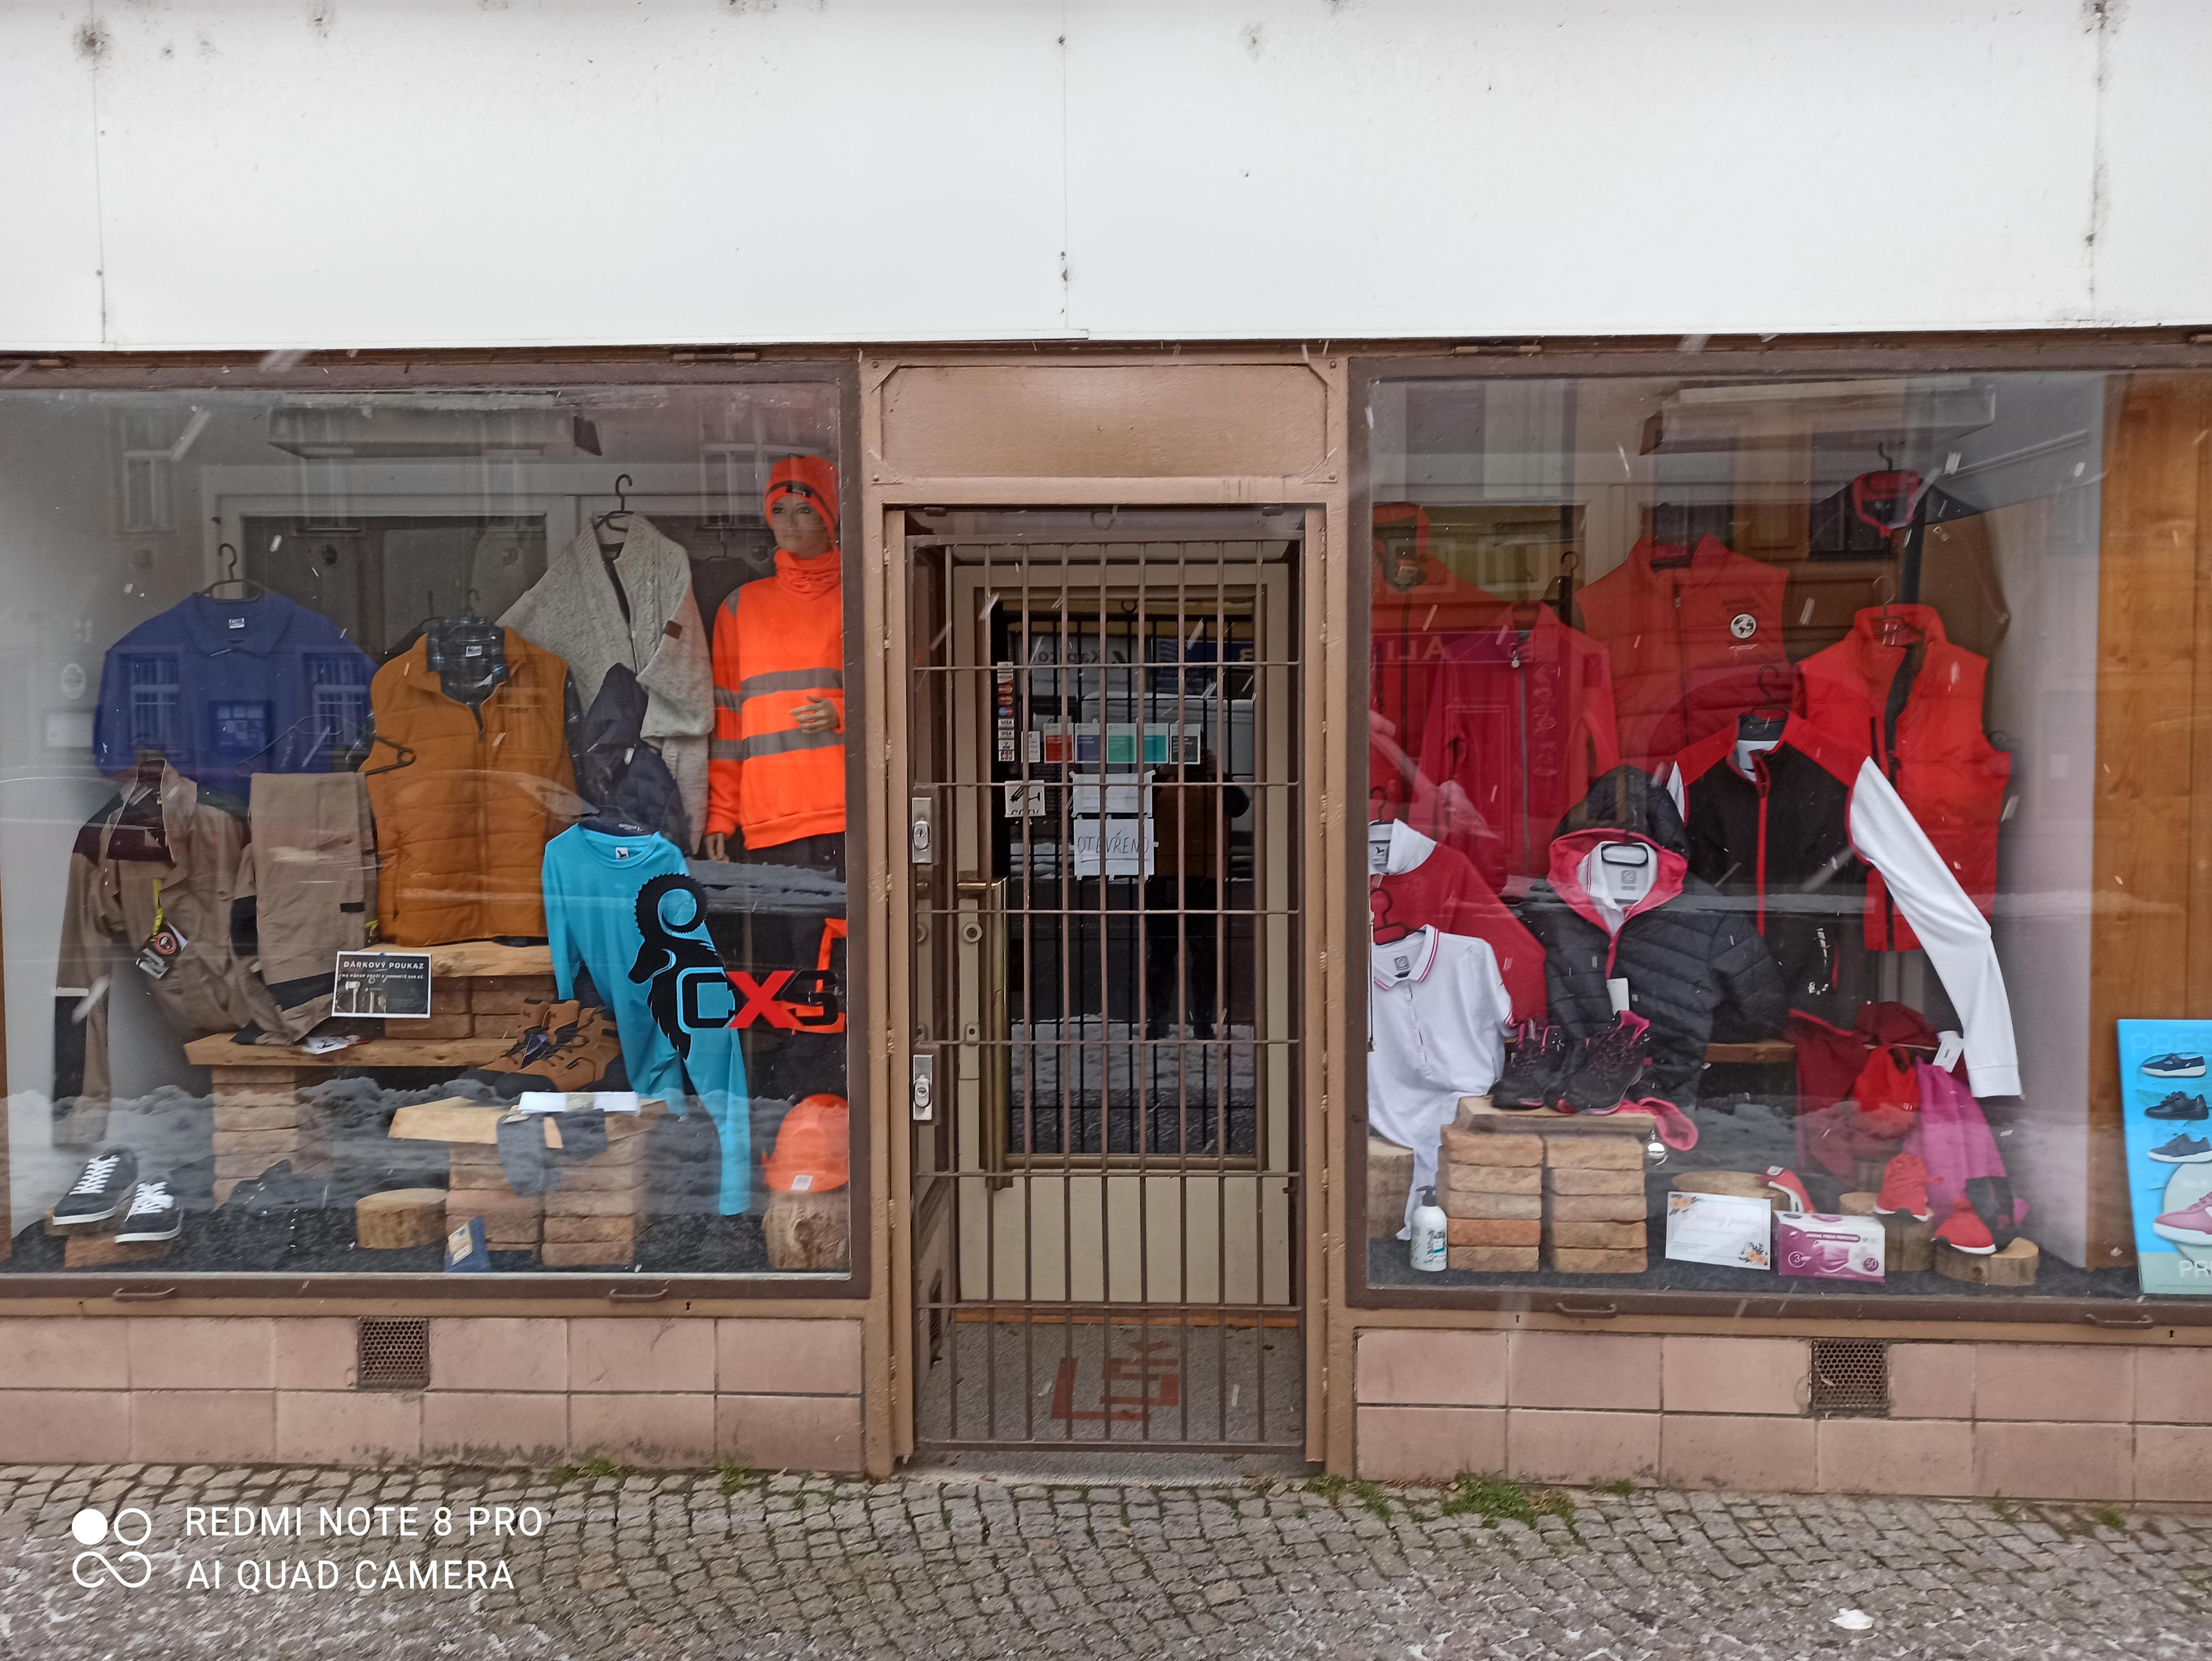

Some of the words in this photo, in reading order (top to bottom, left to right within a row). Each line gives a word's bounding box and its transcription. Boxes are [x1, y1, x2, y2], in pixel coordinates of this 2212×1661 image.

[343, 960, 386, 969] DÁRKOVÝ
[389, 961, 425, 969] POUKAZ
[680, 969, 839, 1029] CXS
[1865, 1260, 1878, 1268] 50
[2179, 1259, 2212, 1278] PR
